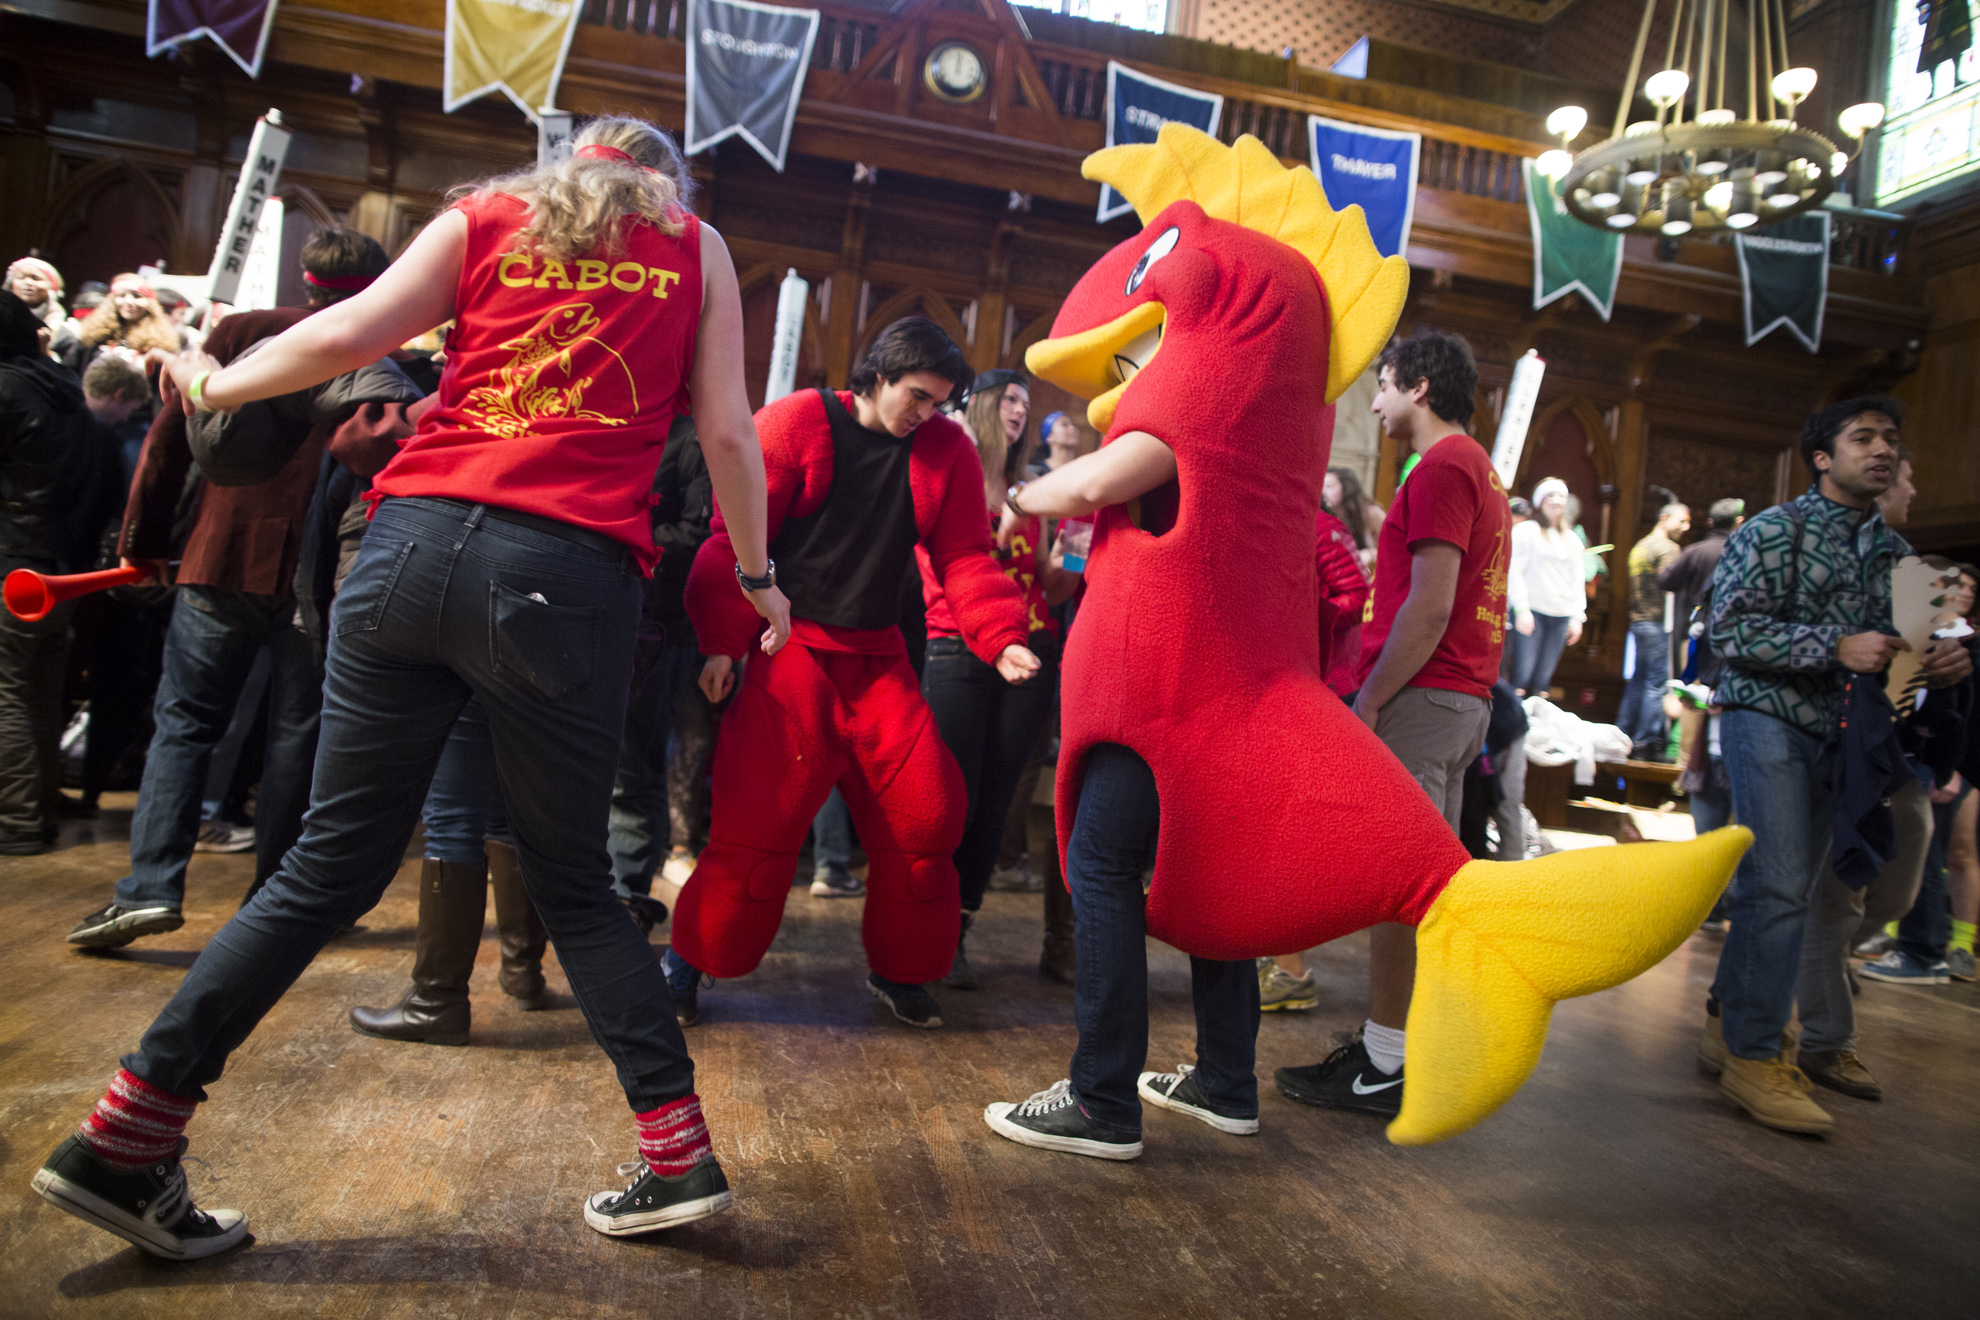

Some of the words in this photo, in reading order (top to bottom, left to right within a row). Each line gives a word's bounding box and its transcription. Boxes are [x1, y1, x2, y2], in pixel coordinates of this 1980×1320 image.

[701, 28, 799, 60] STOUGHTON
[1331, 153, 1397, 181] THAYER
[224, 155, 276, 273] MATHER
[498, 253, 680, 299] CABOT
